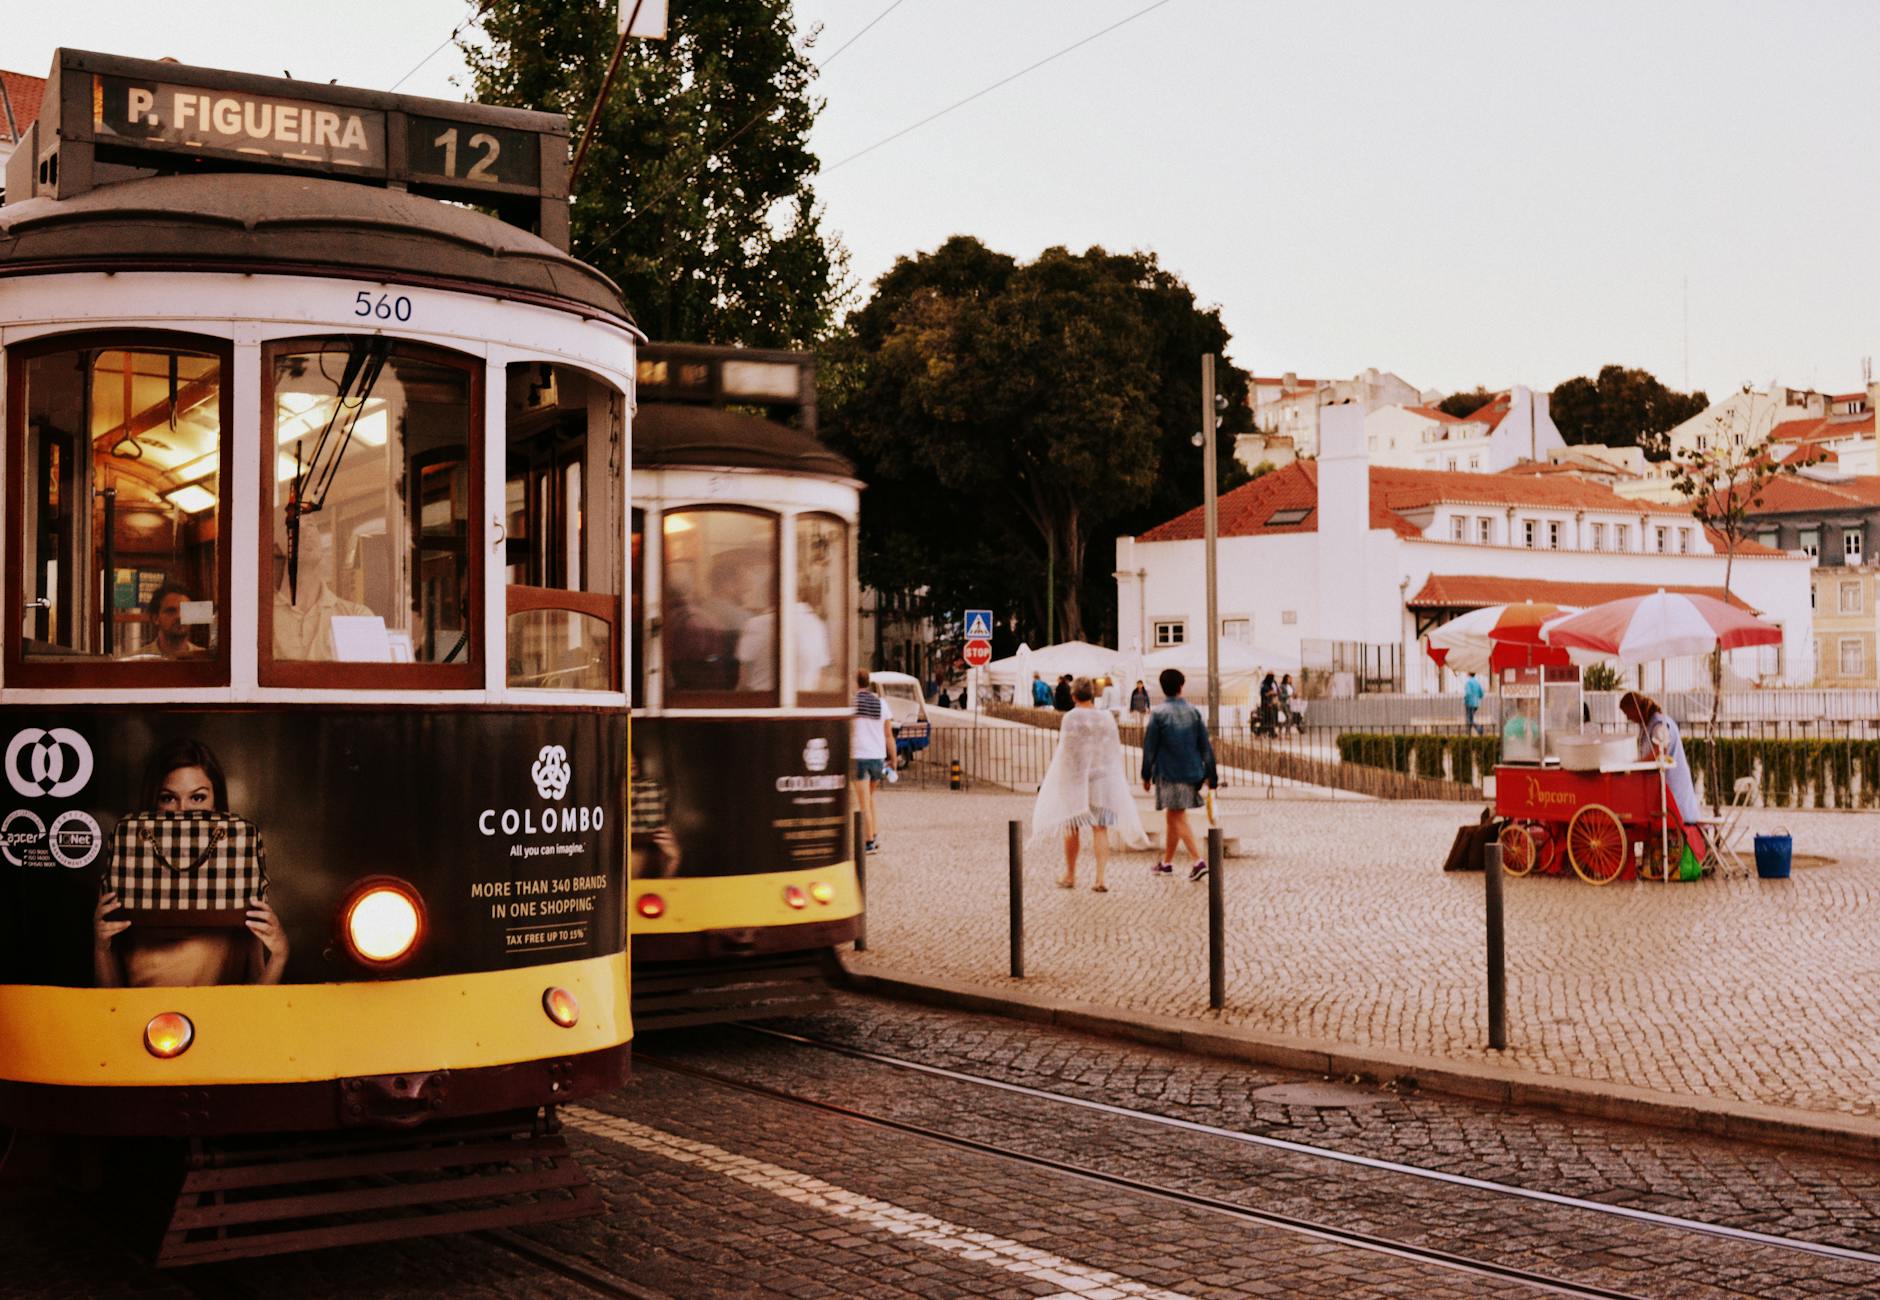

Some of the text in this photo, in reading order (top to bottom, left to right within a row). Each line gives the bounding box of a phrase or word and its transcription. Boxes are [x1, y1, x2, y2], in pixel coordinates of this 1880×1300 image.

[128, 88, 368, 150] P. FIGUEIRA
[434, 127, 501, 184] 12
[355, 291, 412, 322] 560
[966, 648, 990, 657] STOP
[1525, 776, 1577, 806] Popcorn
[479, 806, 604, 836] COLOMBO
[7, 832, 39, 847] apcer
[510, 844, 523, 857] All
[523, 845, 539, 859] you
[540, 845, 555, 856] can
[471, 875, 607, 898] MORE THAN 340 BRANDS
[491, 904, 506, 919] IN
[510, 902, 537, 918] ONE
[506, 934, 523, 946] TAX
[525, 933, 545, 944] FREE
[546, 932, 558, 943] UP
[558, 930, 569, 941] TO
